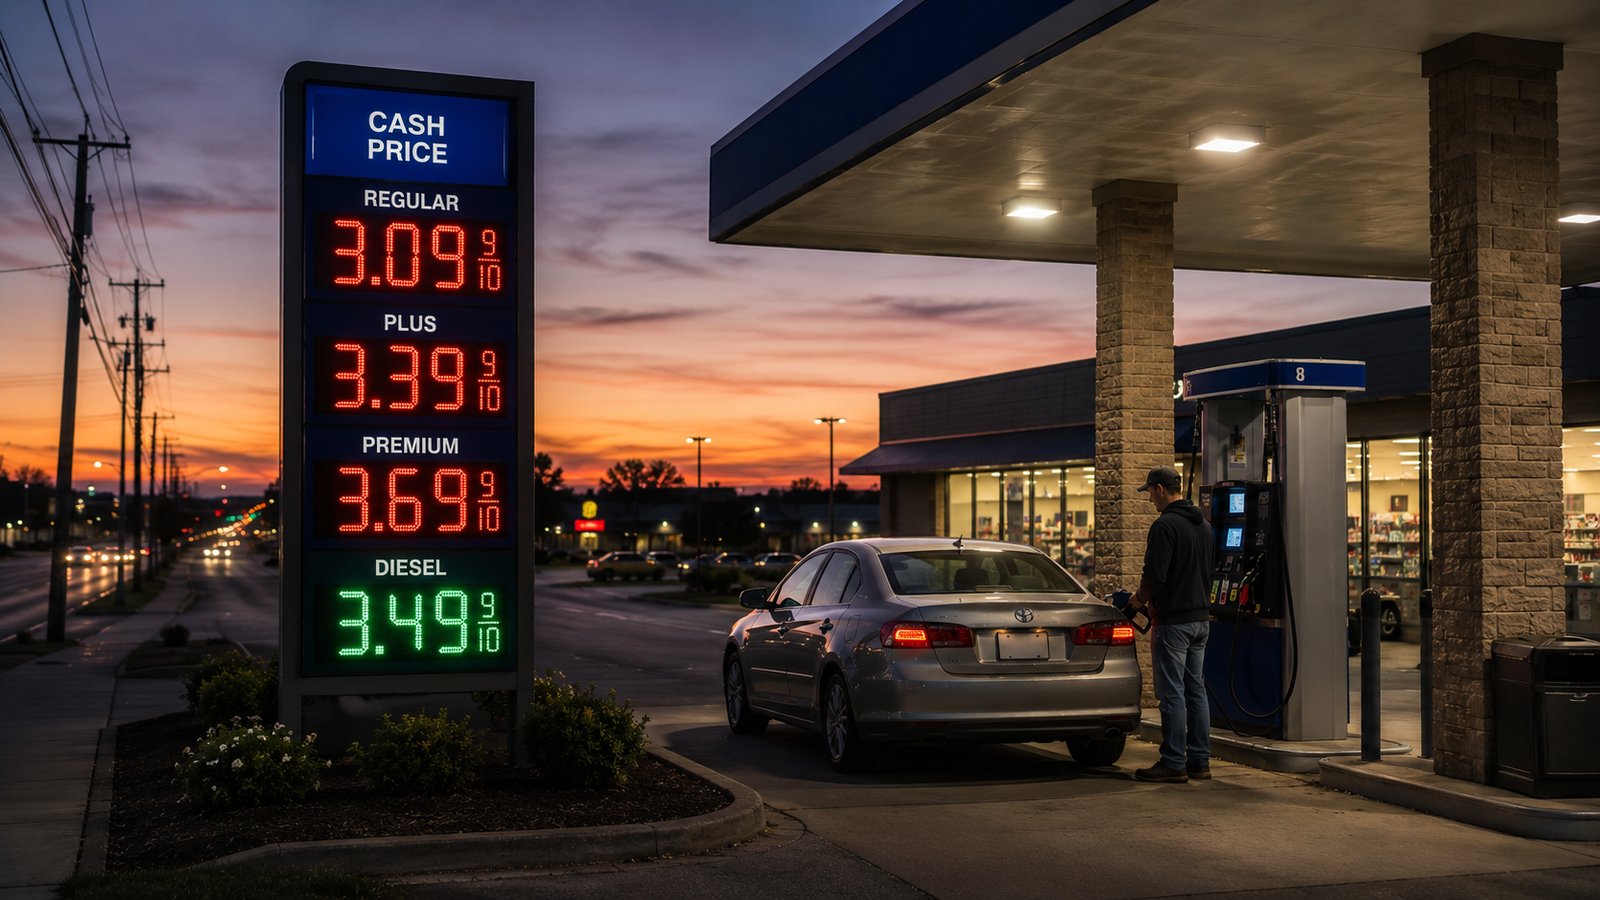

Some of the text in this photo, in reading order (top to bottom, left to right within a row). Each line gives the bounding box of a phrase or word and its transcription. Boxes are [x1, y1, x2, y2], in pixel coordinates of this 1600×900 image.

[368, 111, 444, 136] CASH
[368, 139, 447, 163] PRICE
[364, 190, 458, 211] REGULAR
[335, 220, 465, 289] 3.09
[384, 314, 436, 332] PLUS
[335, 344, 464, 410] 3.39
[1296, 367, 1305, 381] 8
[362, 437, 458, 454] PREMIUM
[339, 467, 467, 531] 3.69
[375, 559, 446, 575] DIESEL
[339, 590, 468, 656] 3.49
